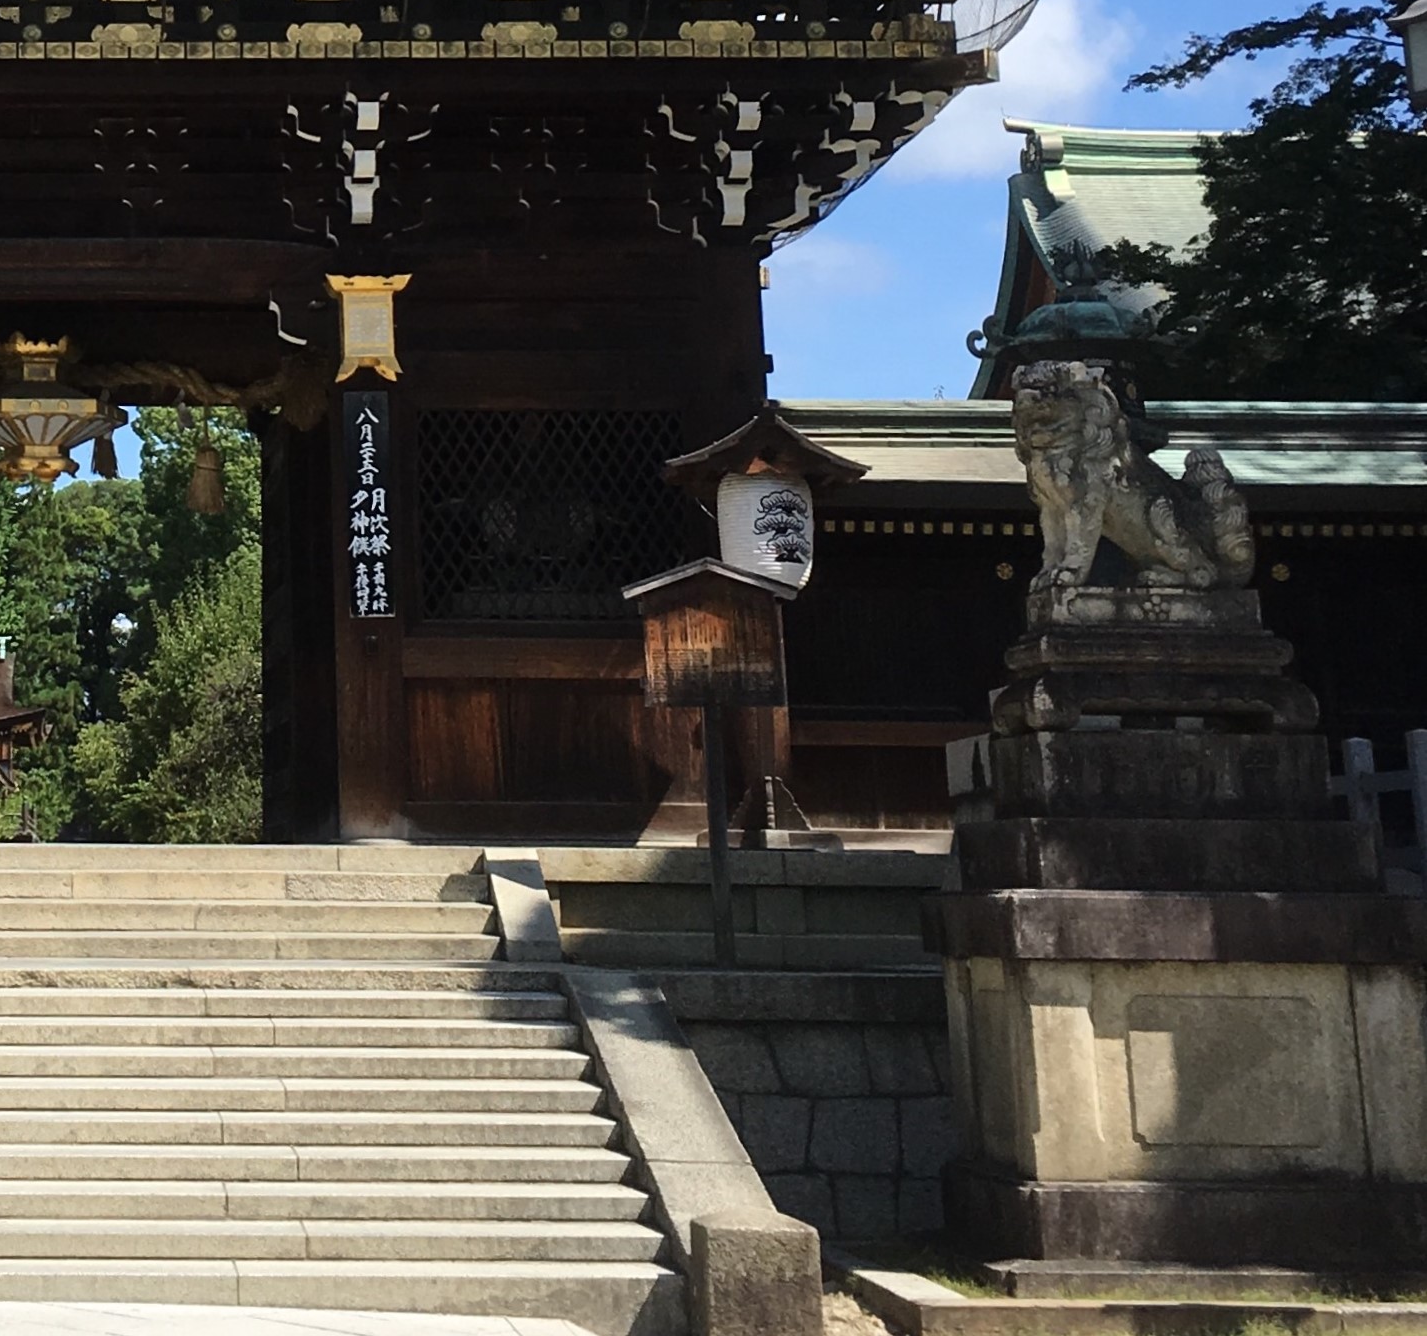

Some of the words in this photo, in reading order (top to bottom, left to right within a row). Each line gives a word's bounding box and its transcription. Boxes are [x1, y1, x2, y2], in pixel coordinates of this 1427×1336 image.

[356, 407, 380, 485] 八月二十五日
[370, 488, 392, 557] 月次祭
